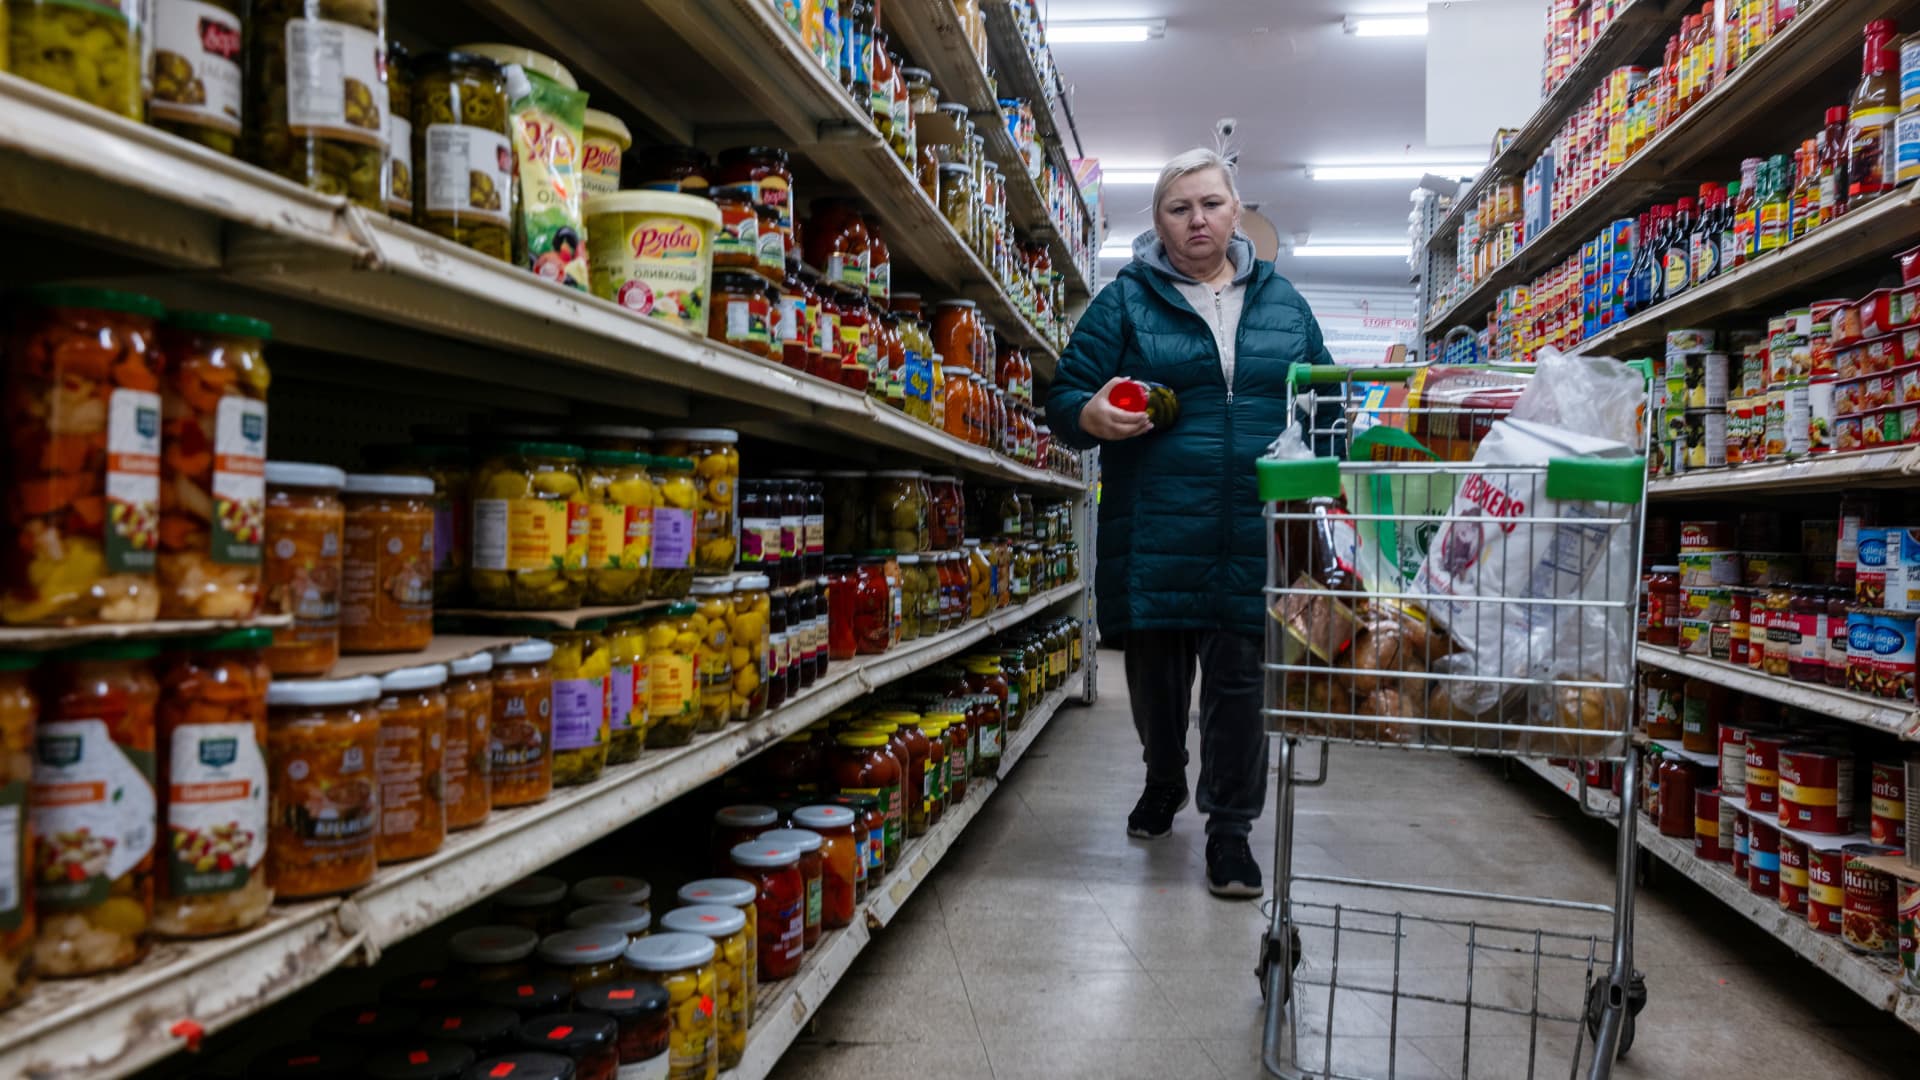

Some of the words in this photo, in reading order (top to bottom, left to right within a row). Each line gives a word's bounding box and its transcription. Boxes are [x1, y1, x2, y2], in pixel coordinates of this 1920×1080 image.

[634, 223, 692, 258] Ряба
[1363, 318, 1392, 328] STORE
[1462, 473, 1524, 535] HECKERS
